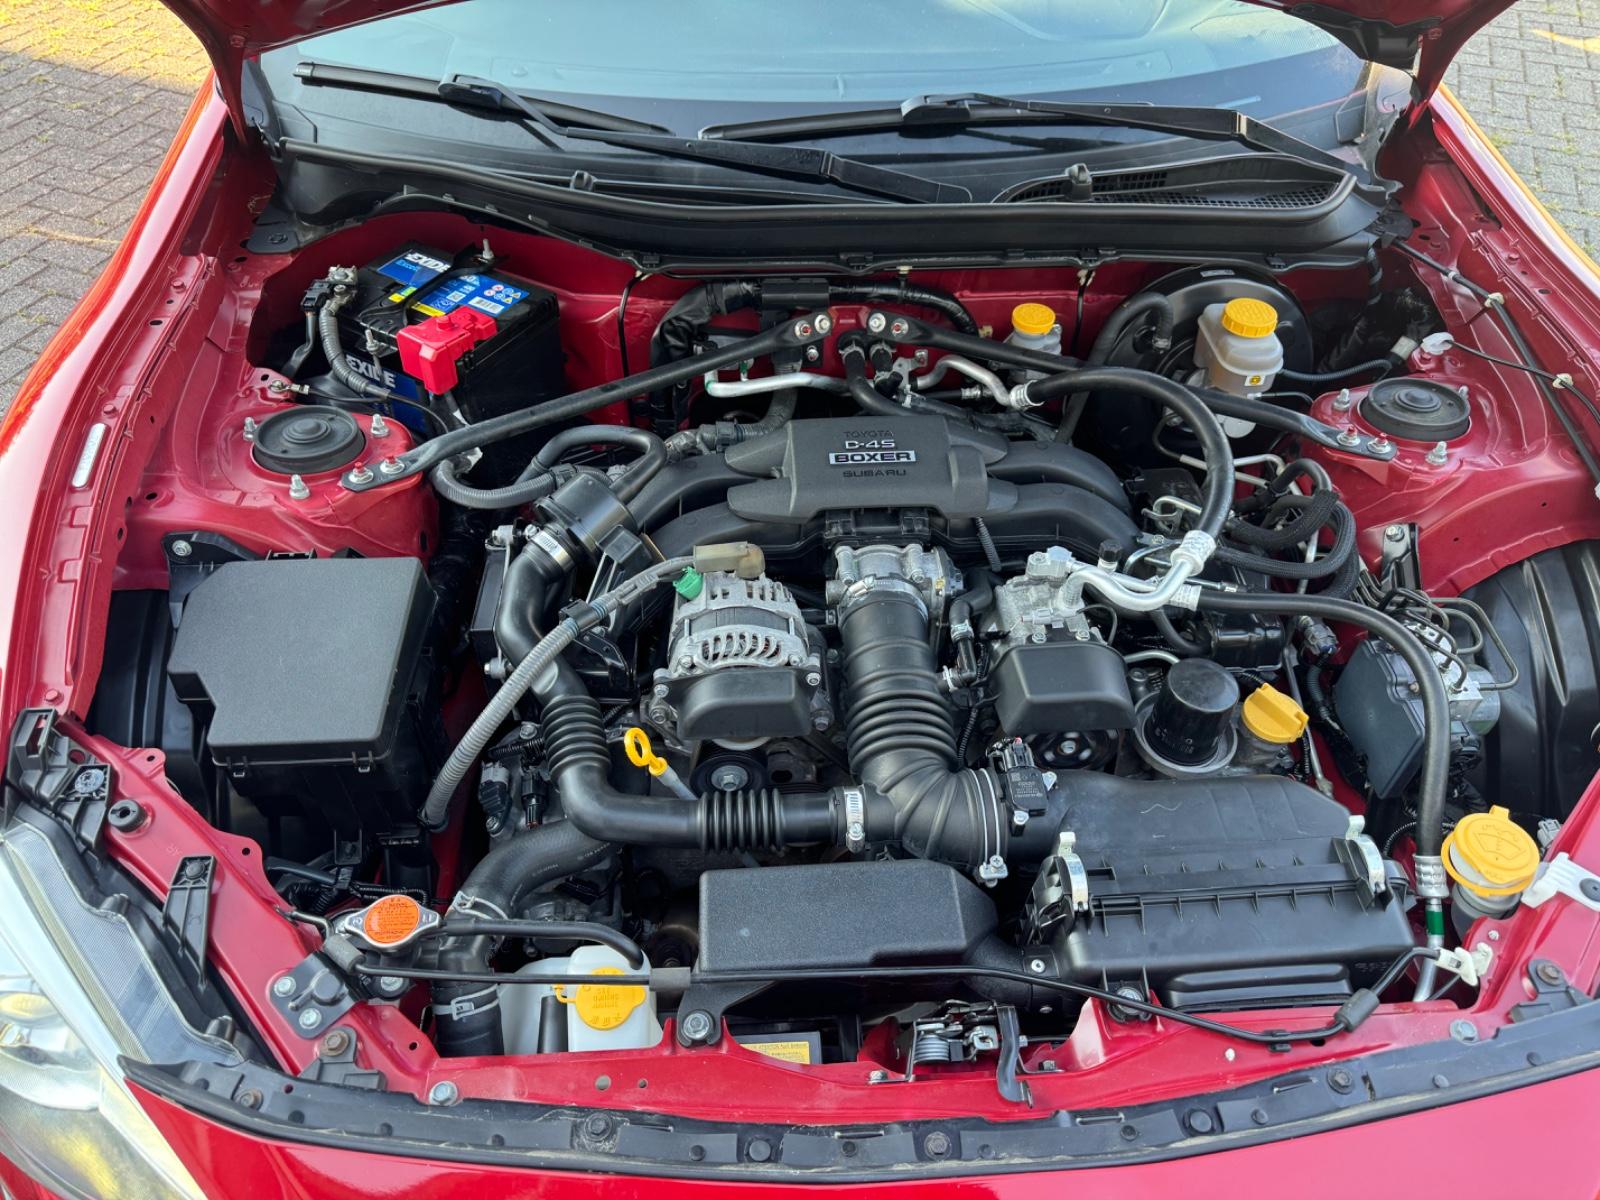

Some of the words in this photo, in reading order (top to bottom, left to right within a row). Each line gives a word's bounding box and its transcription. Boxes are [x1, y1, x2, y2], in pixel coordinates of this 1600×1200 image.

[843, 430, 893, 438] TOYOTA
[845, 439, 896, 449] D-4S
[834, 452, 911, 462] BOXER
[843, 469, 906, 478] SUBARU
